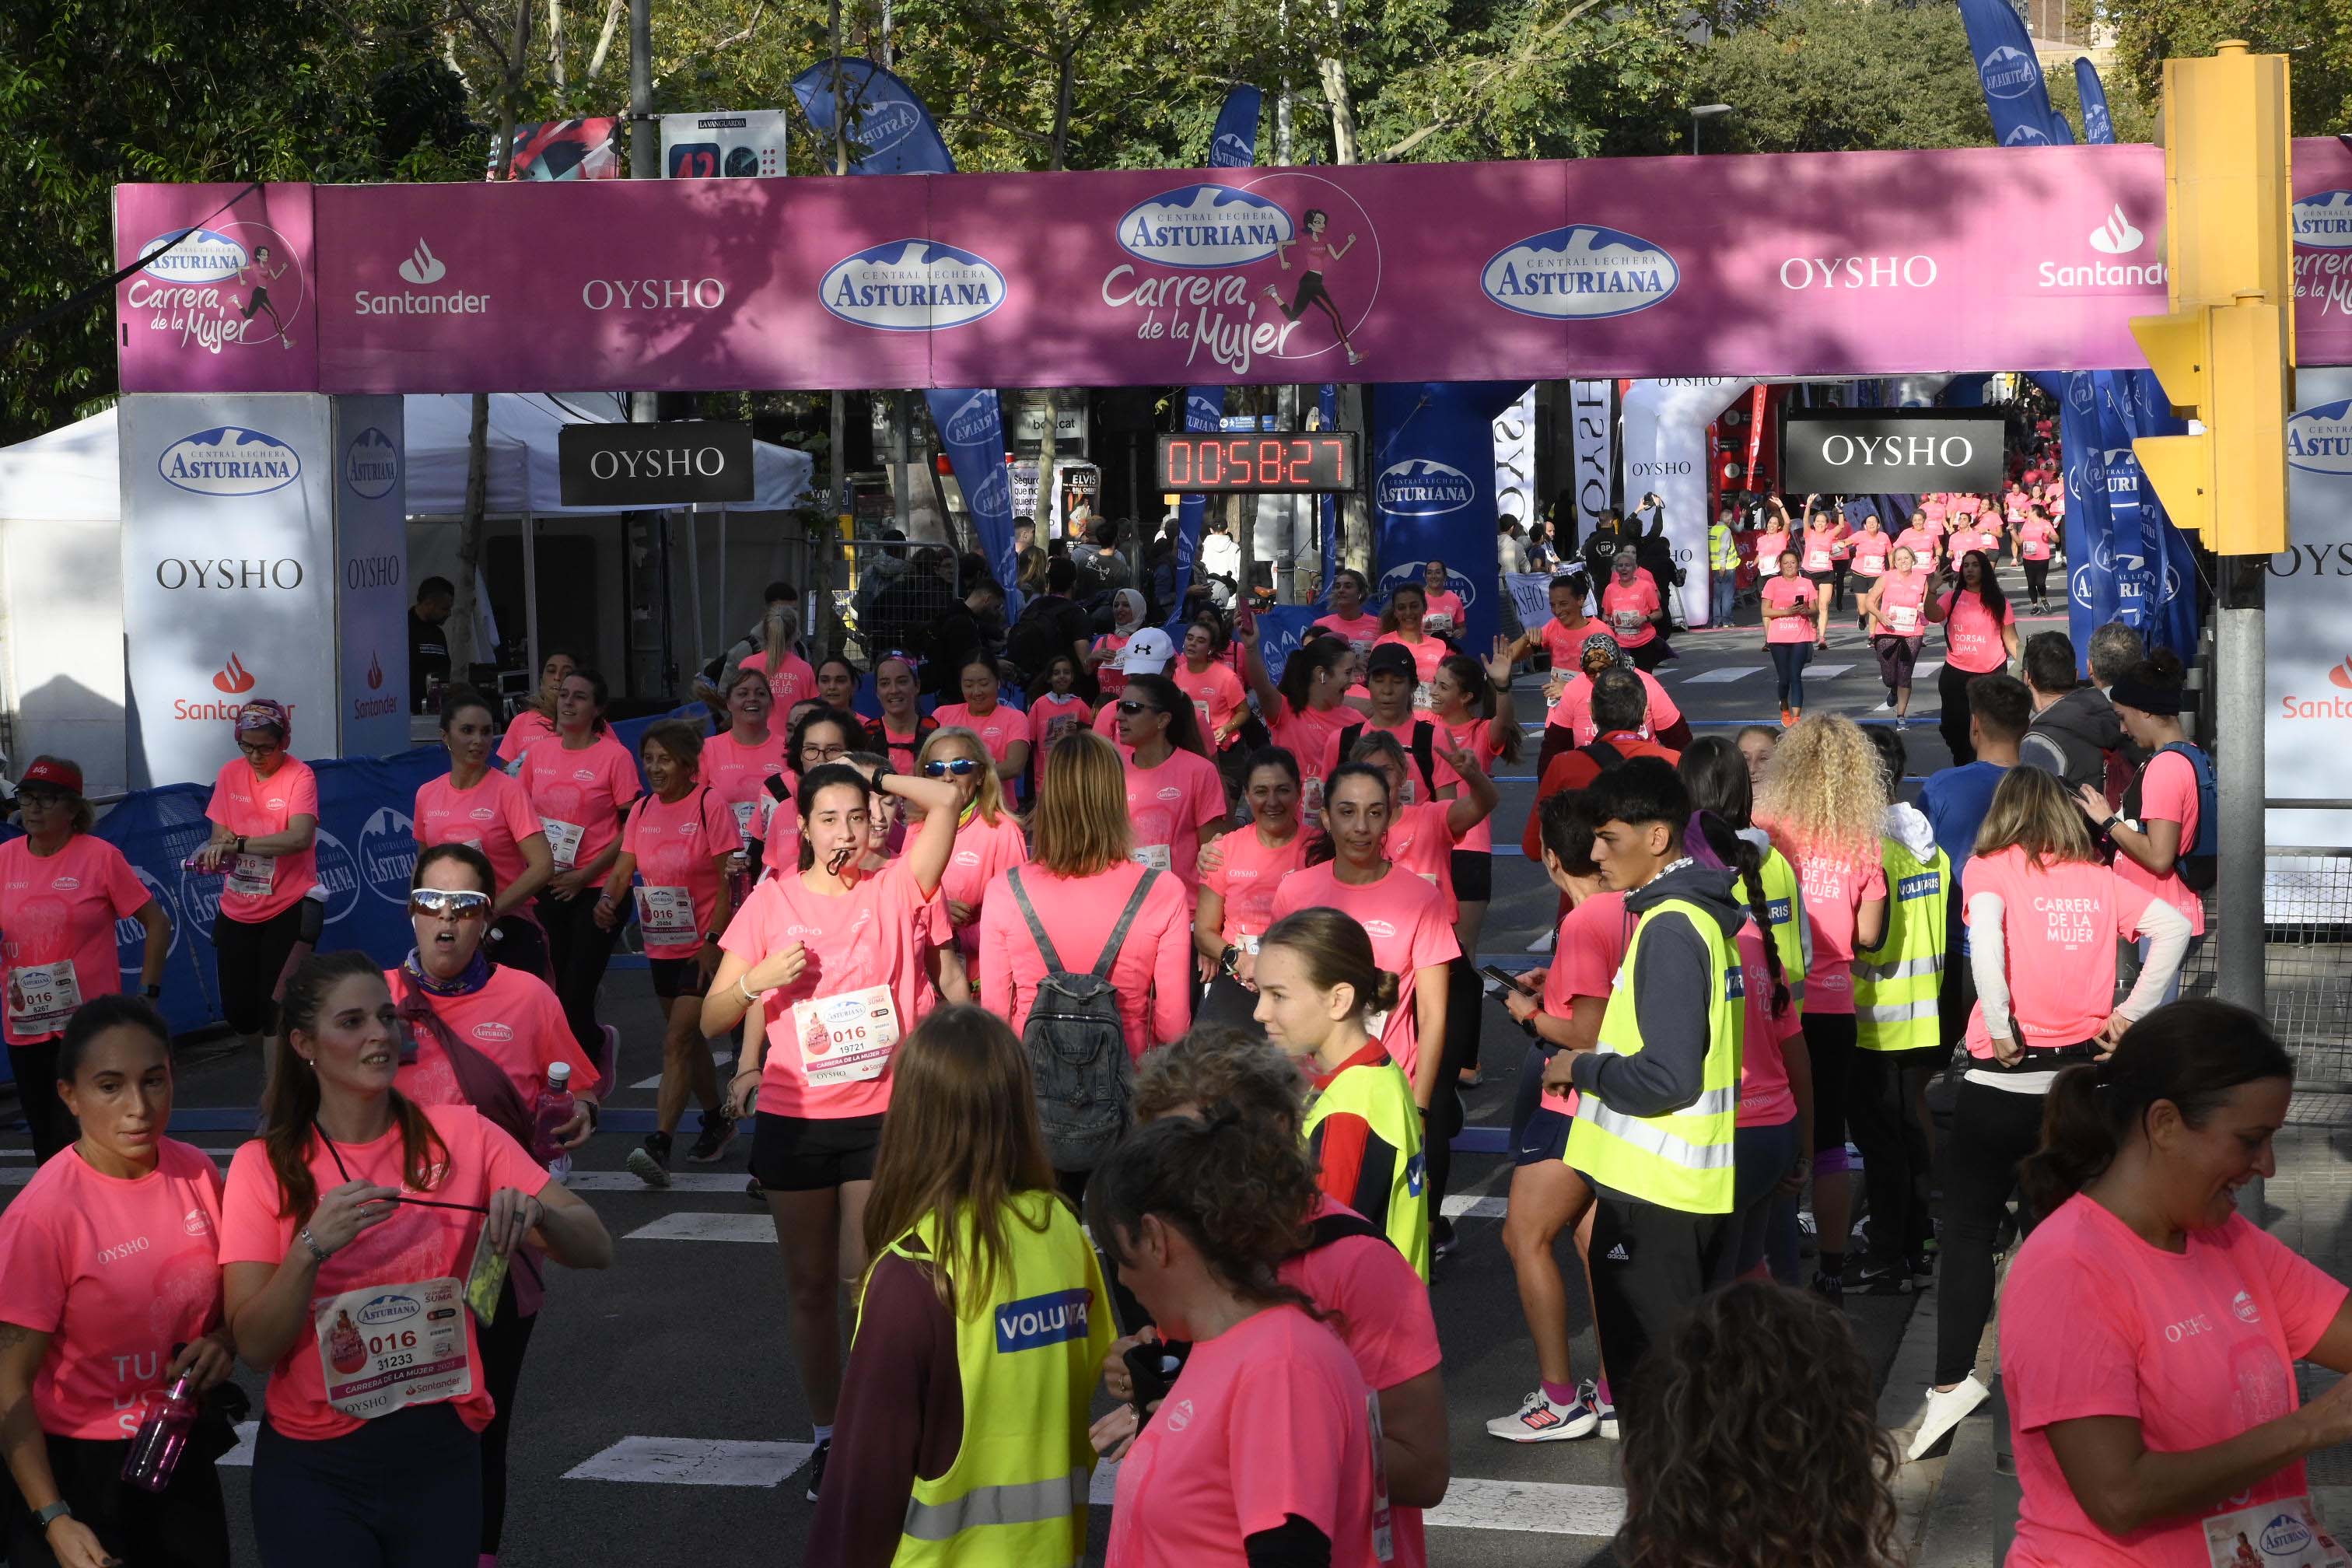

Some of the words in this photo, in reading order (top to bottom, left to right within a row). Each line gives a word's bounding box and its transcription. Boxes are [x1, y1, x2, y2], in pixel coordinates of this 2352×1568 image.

[1157, 212, 1213, 222] CENTRAL
[1219, 212, 1275, 220] LECHERA
[1130, 217, 1279, 247] ASTURIANA
[1527, 257, 1587, 268] CENTRAL
[1594, 256, 1657, 266] LECHERA
[1780, 255, 1937, 289] OYSHO
[862, 270, 924, 279] CENTRAL
[928, 269, 985, 279] LECHERA
[1496, 261, 1664, 296] ASTURIANA
[128, 280, 219, 309] Carrera
[583, 278, 725, 310] OYSHO
[834, 274, 992, 306] ASTURIANA
[1102, 264, 1248, 307] Carrera
[2312, 276, 2324, 297] la
[355, 291, 491, 315] Santander
[151, 311, 167, 330] de
[172, 310, 184, 330] la
[182, 306, 254, 354] Mujer
[1138, 310, 1164, 339] de
[1171, 309, 1189, 339] la
[1186, 301, 1301, 374] Mujer
[1822, 435, 1972, 467] OYSHO
[169, 453, 292, 479] ASTURIANA
[590, 446, 725, 479] OYSHO
[1168, 441, 1343, 485] 00:58:27
[1632, 460, 1691, 475] OYSHO
[1073, 474, 1096, 485] ELVIS
[1380, 481, 1468, 503] ASTURIANA
[156, 558, 303, 590] OYSHO
[348, 555, 400, 590] OYSHO
[1955, 634, 1986, 643] DORSAL
[174, 698, 296, 721] Santar
[355, 696, 397, 720] Santander
[236, 858, 256, 868] 016
[1802, 869, 1818, 883] DE
[1823, 873, 1839, 886] LA
[1800, 883, 1840, 899] MUJER
[653, 909, 673, 919] 016
[2034, 897, 2100, 912] CARRERA
[2048, 913, 2067, 927] DE
[2073, 914, 2091, 927] LA
[2047, 929, 2093, 943] MUJER
[5, 942, 19, 958] TU
[27, 992, 52, 1005] 016
[475, 1028, 511, 1039] ASTURIANA
[833, 1026, 866, 1044] 016
[839, 1043, 865, 1054] 19721
[816, 1058, 843, 1069] CARRERA
[861, 1051, 880, 1060] MUJER
[97, 1237, 149, 1265] OYSHO
[362, 1304, 415, 1322] ASTURIANA
[369, 1330, 417, 1354] 016
[112, 1351, 156, 1382] TU
[378, 1353, 413, 1370] 31233
[345, 1378, 383, 1394] CARRERA
[383, 1374, 393, 1383] DE
[394, 1371, 404, 1380] LA
[406, 1366, 434, 1377] MUJER
[437, 1361, 455, 1371] 2023
[416, 1376, 461, 1394] Santander
[345, 1395, 387, 1414] OYSHO
